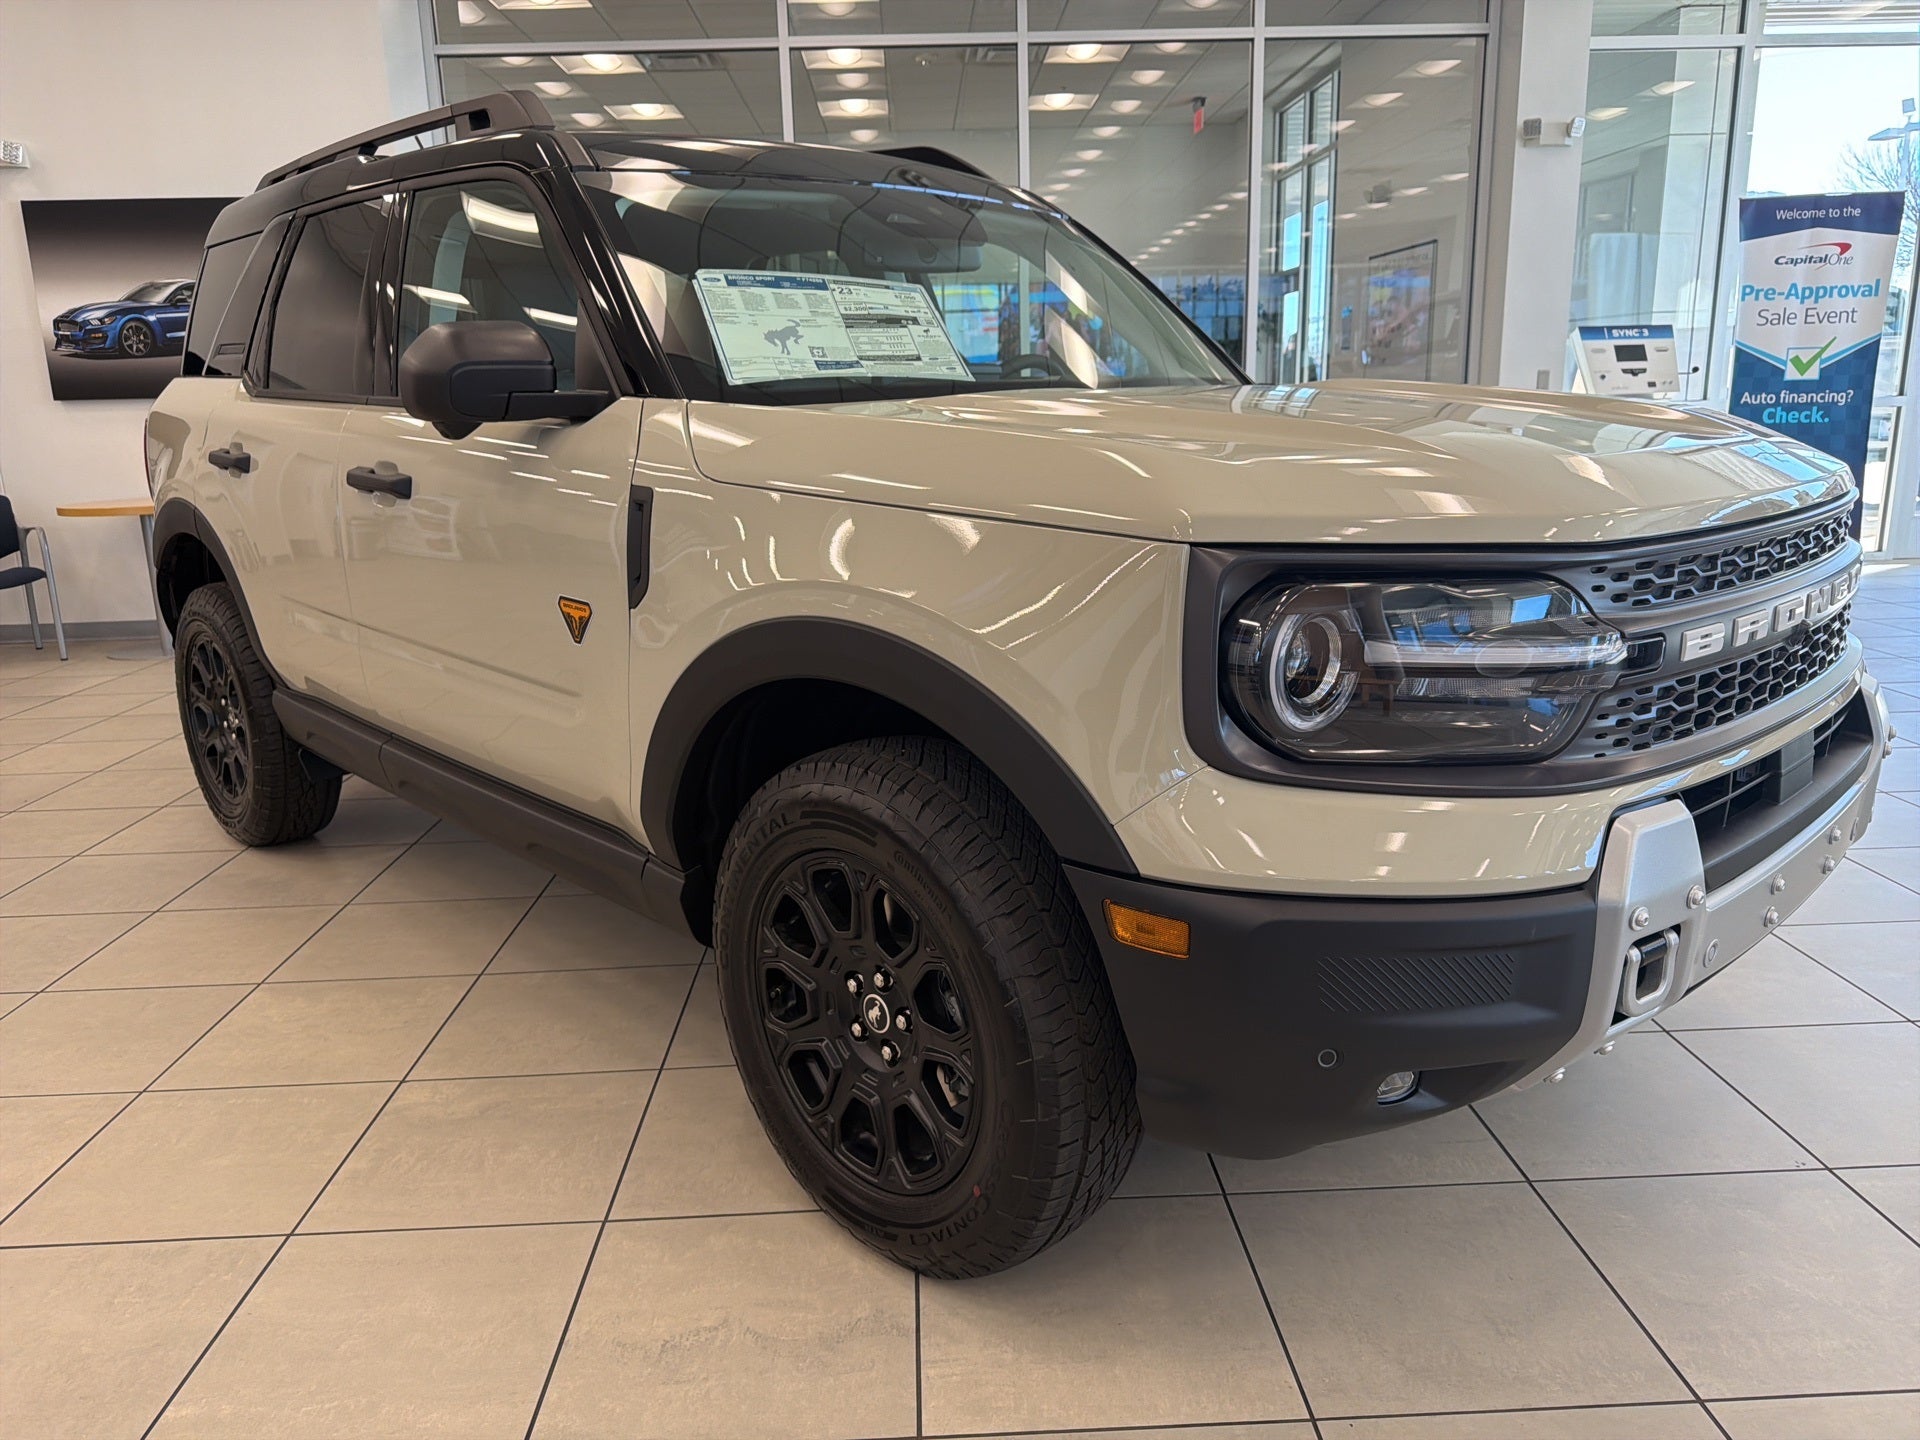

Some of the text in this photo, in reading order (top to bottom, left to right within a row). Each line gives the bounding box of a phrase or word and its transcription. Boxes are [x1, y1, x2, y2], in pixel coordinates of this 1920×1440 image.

[1776, 206, 1861, 220] Welcome to the
[1741, 280, 1881, 304] Pre-Approval
[1756, 307, 1858, 326] Sale Event
[1642, 328, 1649, 336] 3
[1740, 390, 1853, 406] Auto financing?
[1762, 407, 1830, 424] Check.
